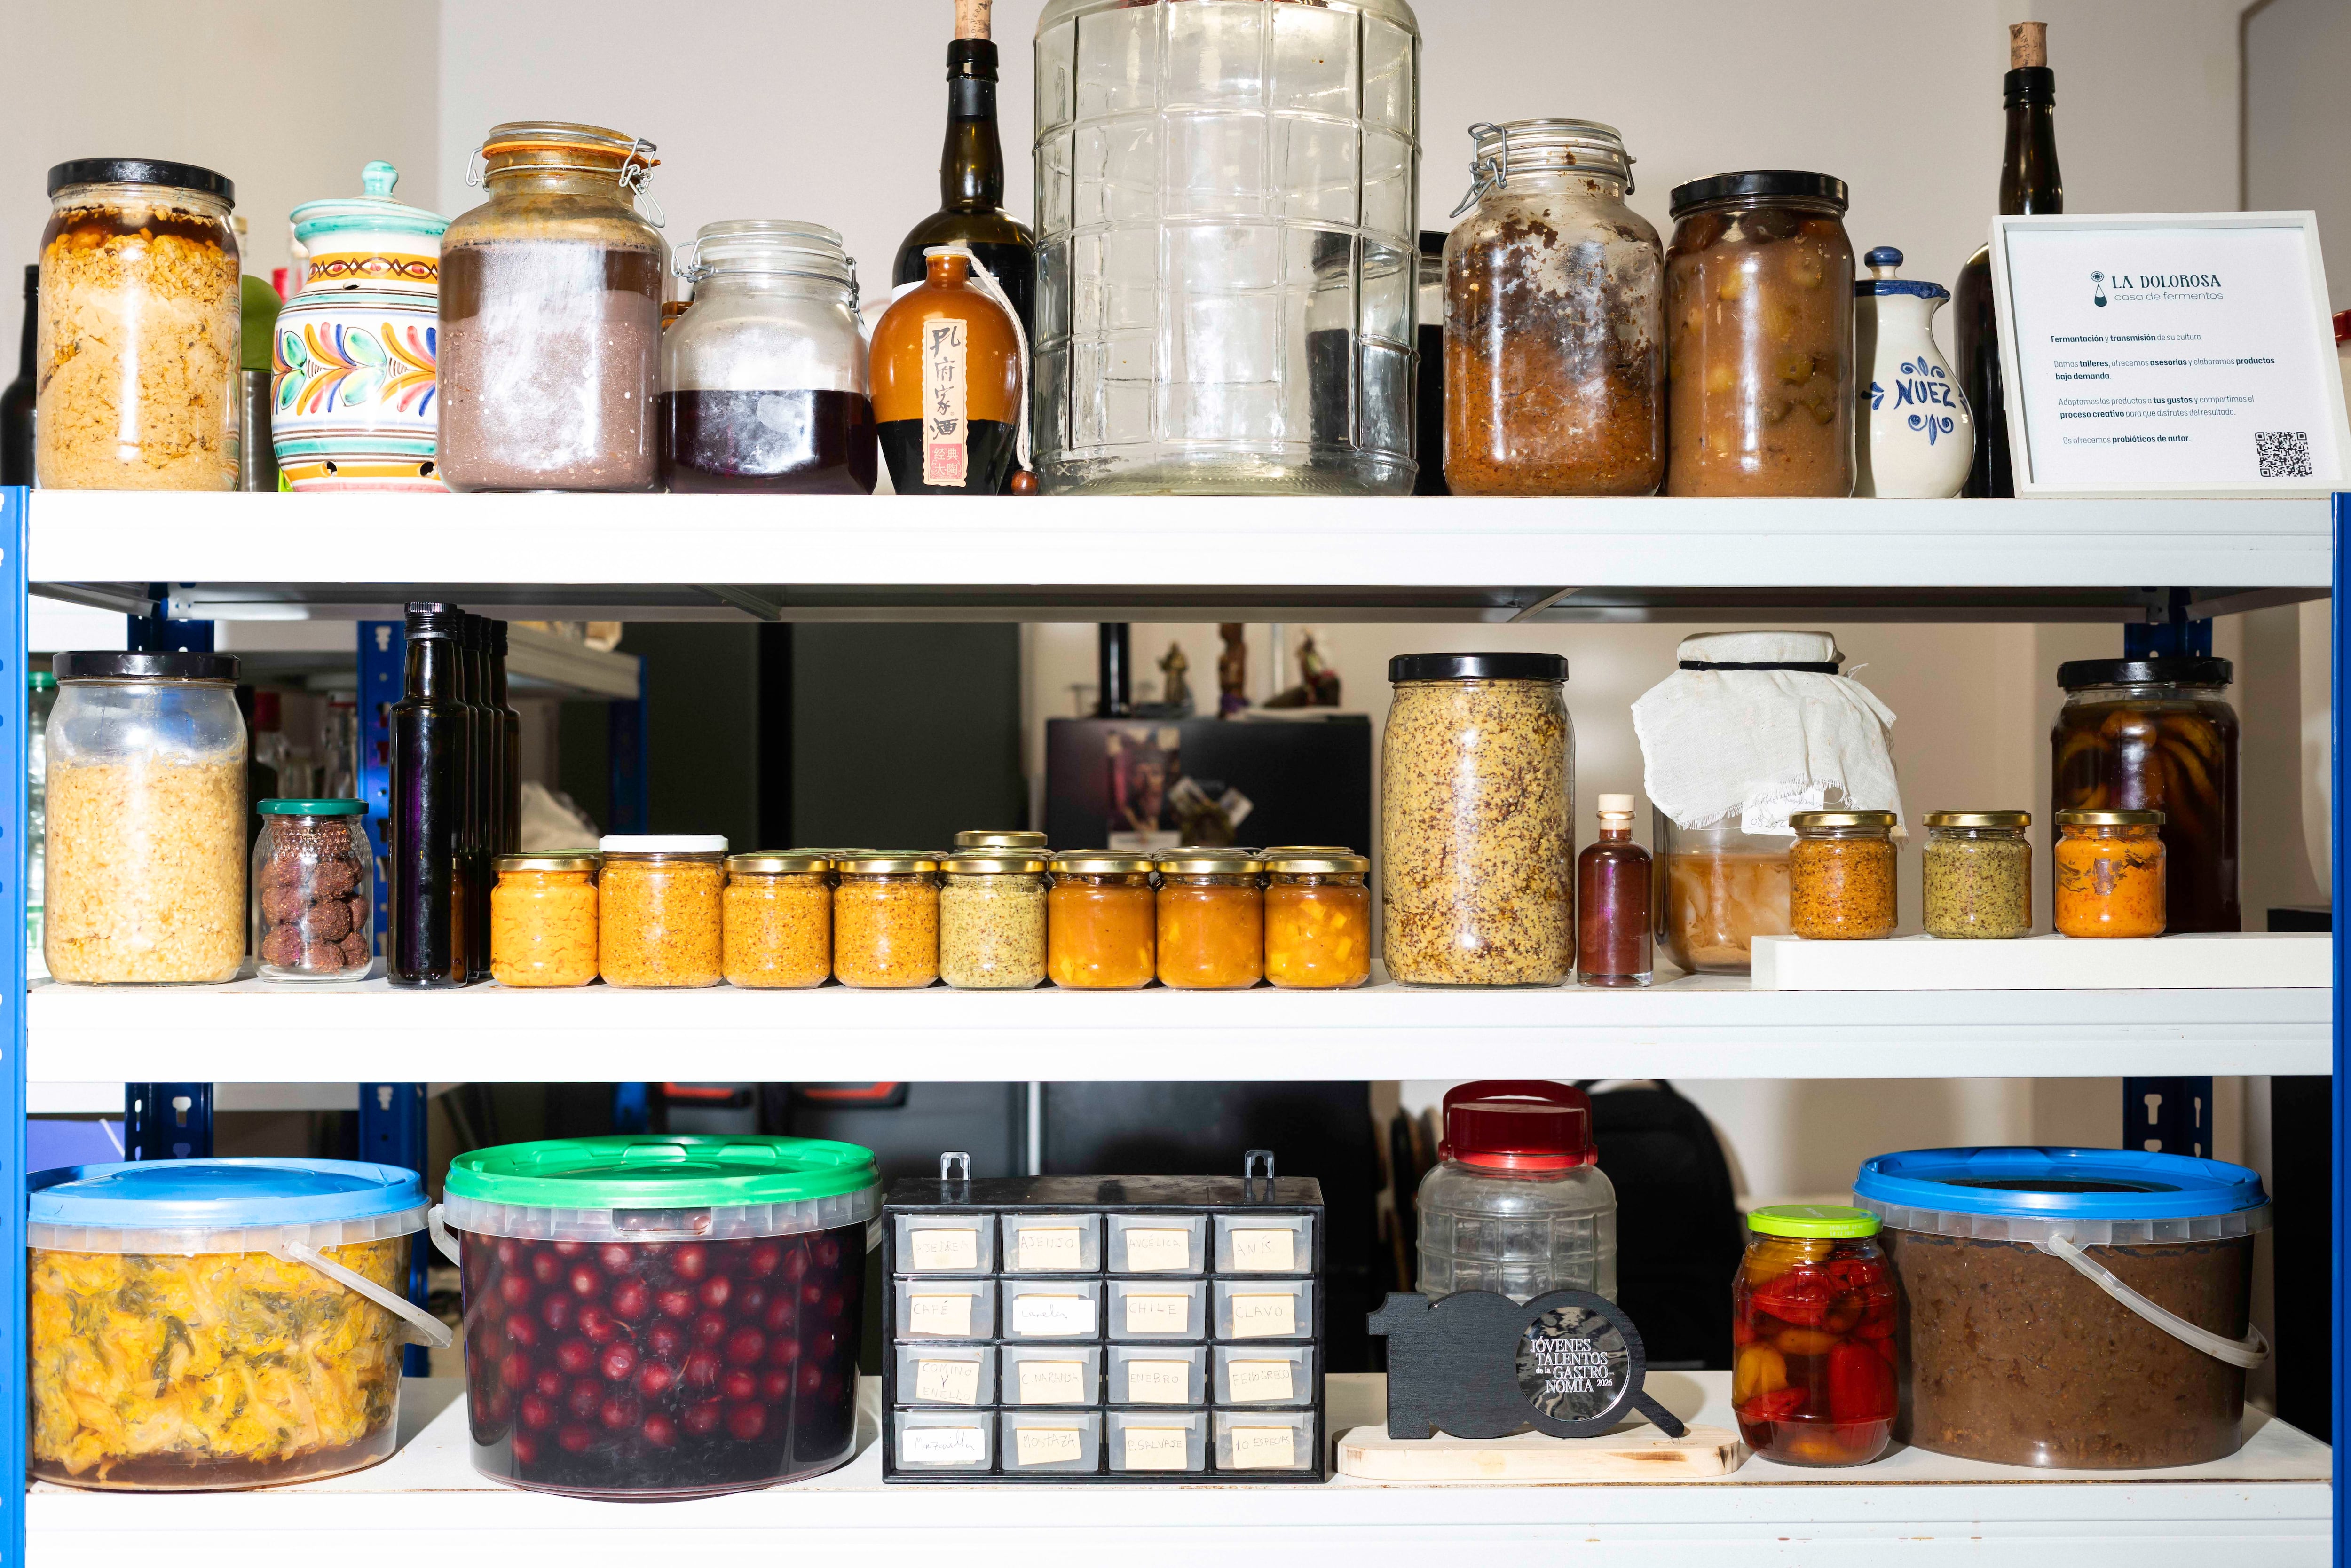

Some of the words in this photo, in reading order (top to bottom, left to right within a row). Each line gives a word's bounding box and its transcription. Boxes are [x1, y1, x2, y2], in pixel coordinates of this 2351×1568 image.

[2112, 276, 2133, 289] LA
[2140, 274, 2222, 288] DOLOROSA
[2146, 292, 2161, 300] de
[2163, 292, 2224, 300] fermentos
[2051, 334, 2104, 343] Fermantación
[2176, 333, 2203, 341] cultura.
[2080, 360, 2110, 368] talleres,
[2236, 357, 2275, 365] productos
[2055, 373, 2072, 381] bajo
[1893, 378, 1956, 410] NUEZ
[2111, 397, 2146, 406] productos
[2167, 396, 2193, 405] gustos
[2200, 395, 2247, 404] compartimos
[2060, 411, 2091, 419] proceso
[2112, 435, 2156, 444] probióticos
[1020, 1236, 1074, 1249] AJENJO
[1128, 1233, 1181, 1249] ANGÉLICA
[1237, 1235, 1271, 1256] ANÍS
[914, 1300, 948, 1315] CAFÉ
[1128, 1302, 1177, 1315] CHILE
[1235, 1306, 1283, 1318] CLAVO
[1530, 1335, 1591, 1353] JÓVENES
[1535, 1351, 1608, 1366] TALENTOS
[923, 1363, 972, 1377] COMINO
[1553, 1365, 1615, 1379] GASTRO-
[940, 1374, 949, 1389] Y
[1130, 1372, 1179, 1384] ENEBRO
[1232, 1369, 1290, 1387] FENOGRECO
[1545, 1376, 1594, 1393] NOMÍA
[923, 1387, 970, 1401] ENELDO
[1023, 1432, 1075, 1449] MOSTAZA
[1235, 1439, 1249, 1451] 10
[1253, 1435, 1290, 1447] ESPECIAS
